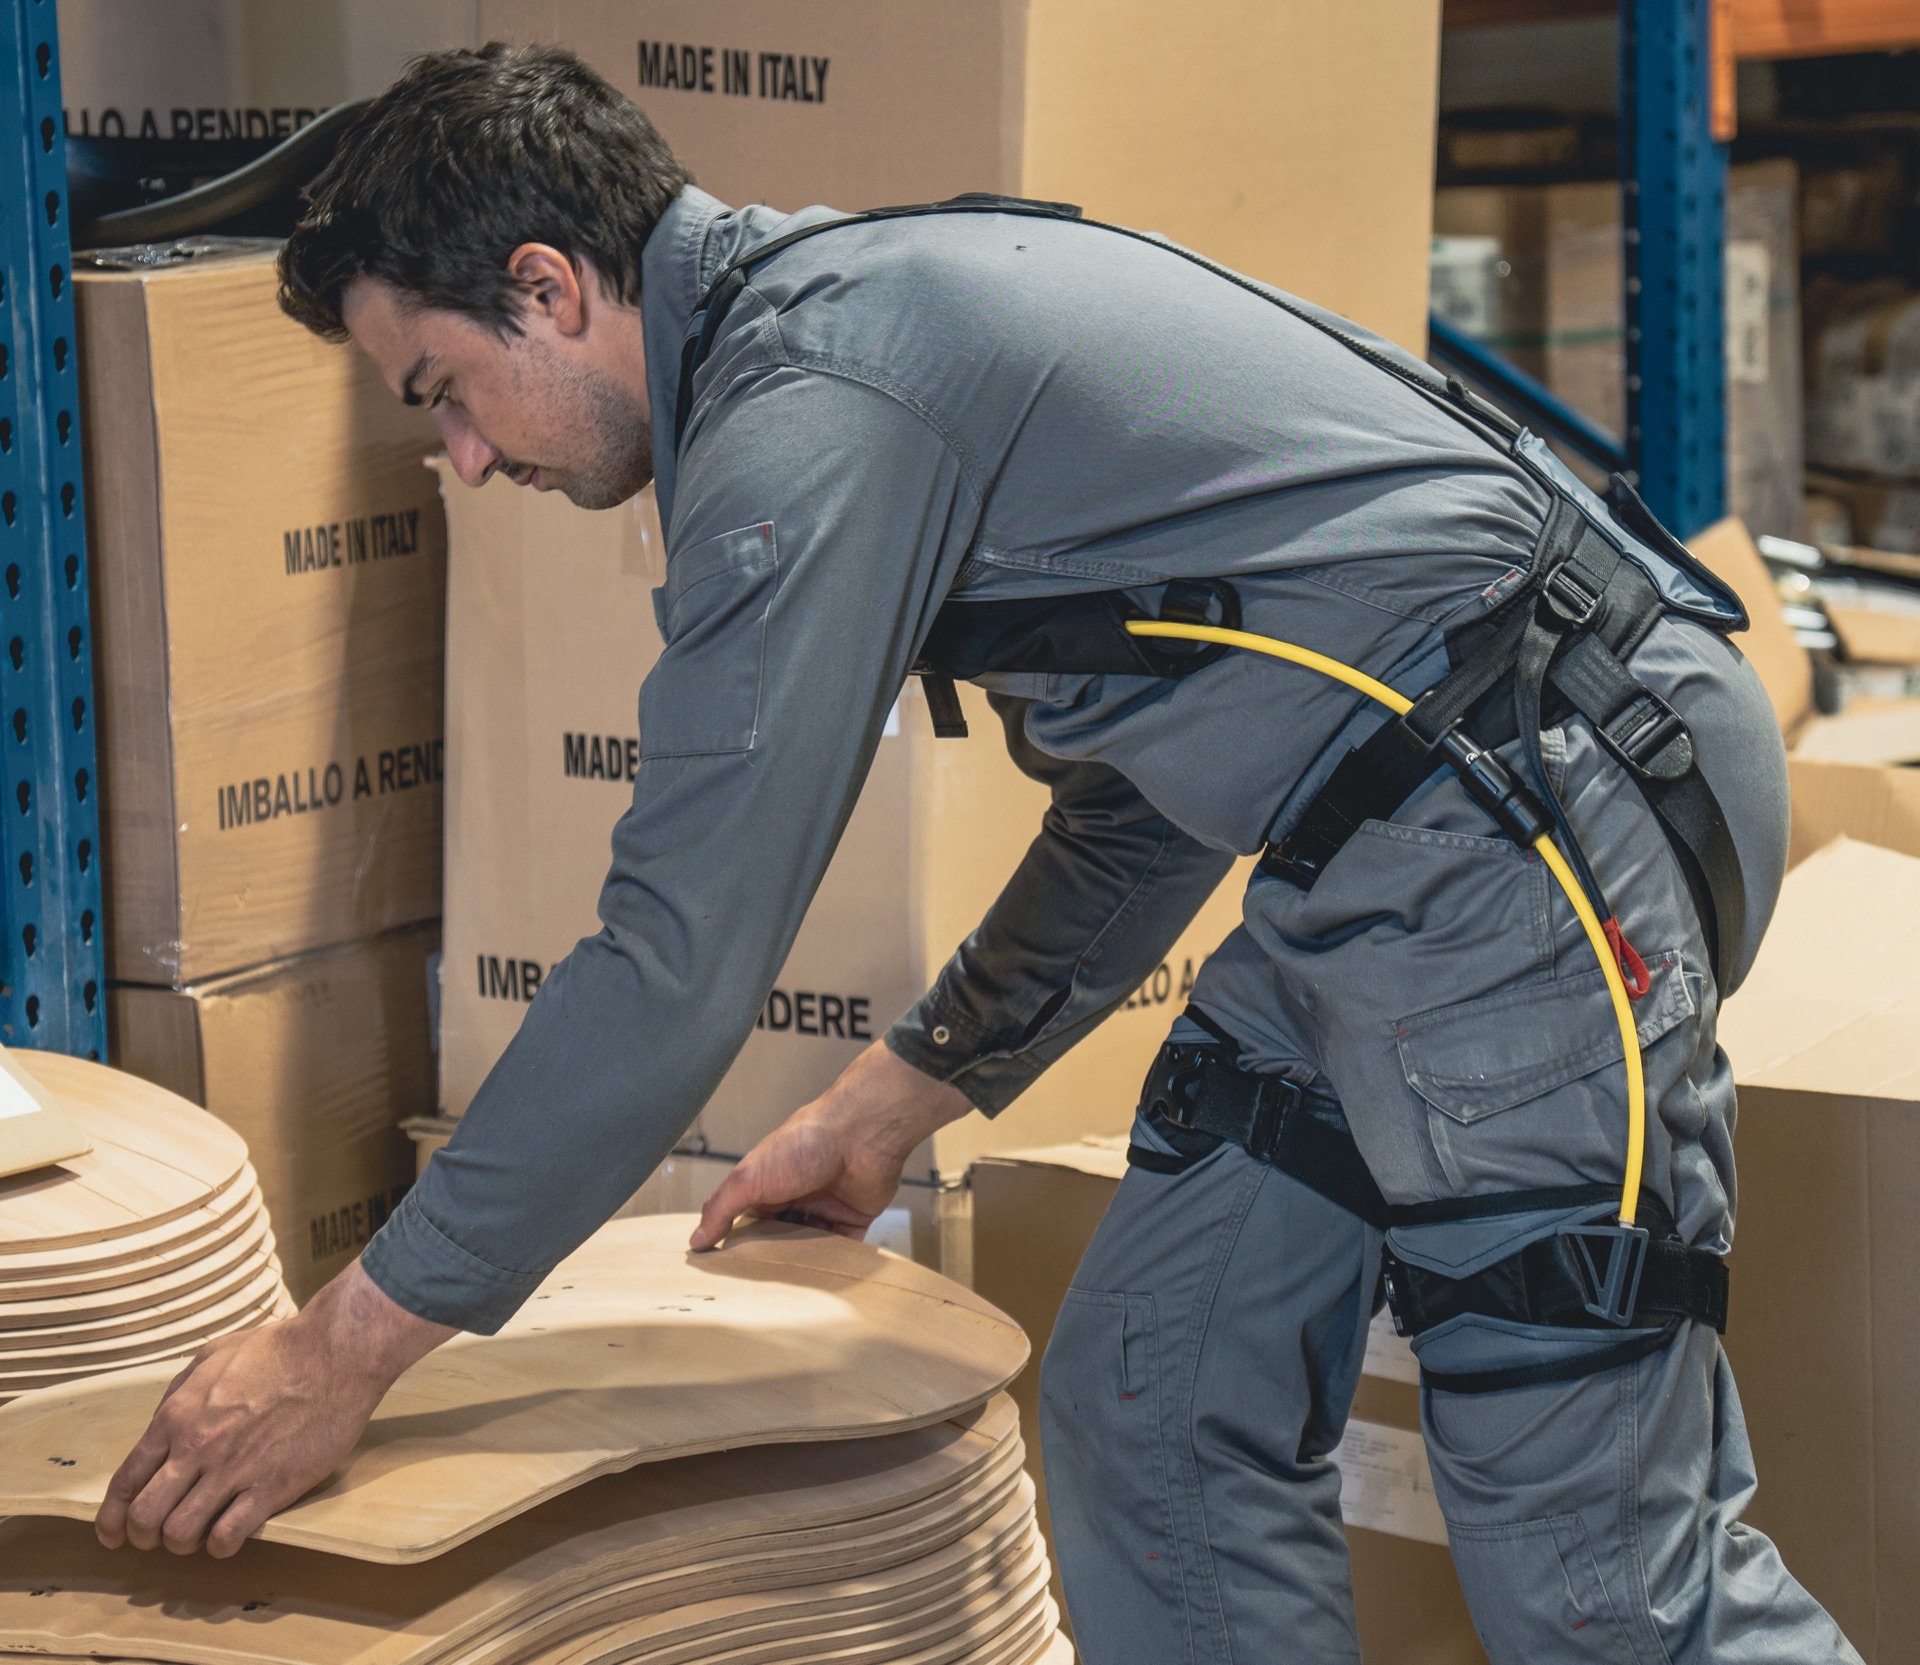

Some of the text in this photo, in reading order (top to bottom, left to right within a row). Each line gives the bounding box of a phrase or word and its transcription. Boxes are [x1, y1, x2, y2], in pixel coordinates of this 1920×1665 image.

[638, 40, 829, 103] MADE IN ITALY
[284, 509, 417, 576] MADE IN ITALY
[563, 732, 638, 783] MADE
[218, 761, 343, 831] IMBALLO
[353, 756, 371, 800] A
[477, 953, 872, 1041] IMB DERE
[1179, 957, 1194, 1000] A
[310, 1201, 363, 1261] MADE
